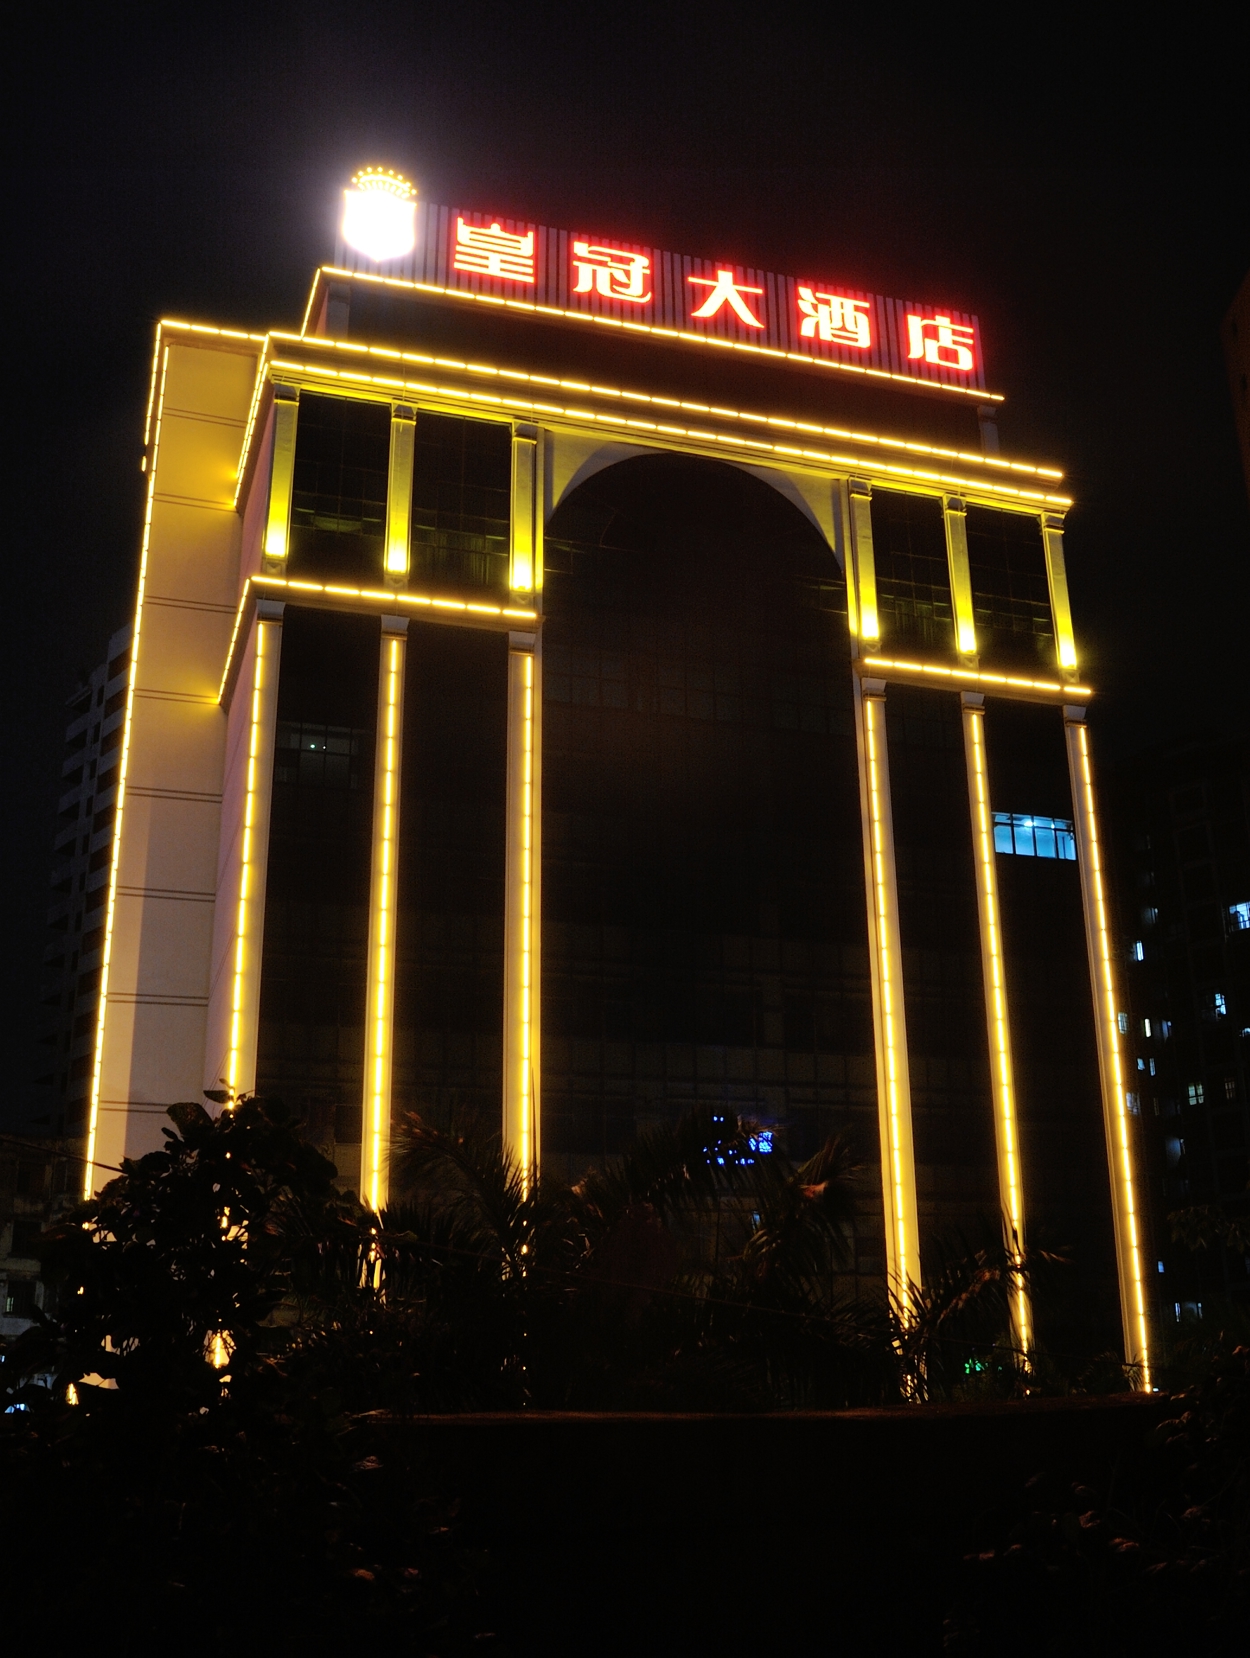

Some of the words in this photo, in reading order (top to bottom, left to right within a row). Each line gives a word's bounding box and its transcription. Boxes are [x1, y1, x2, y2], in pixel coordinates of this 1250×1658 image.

[453, 216, 974, 372] 皇冠大酒店
